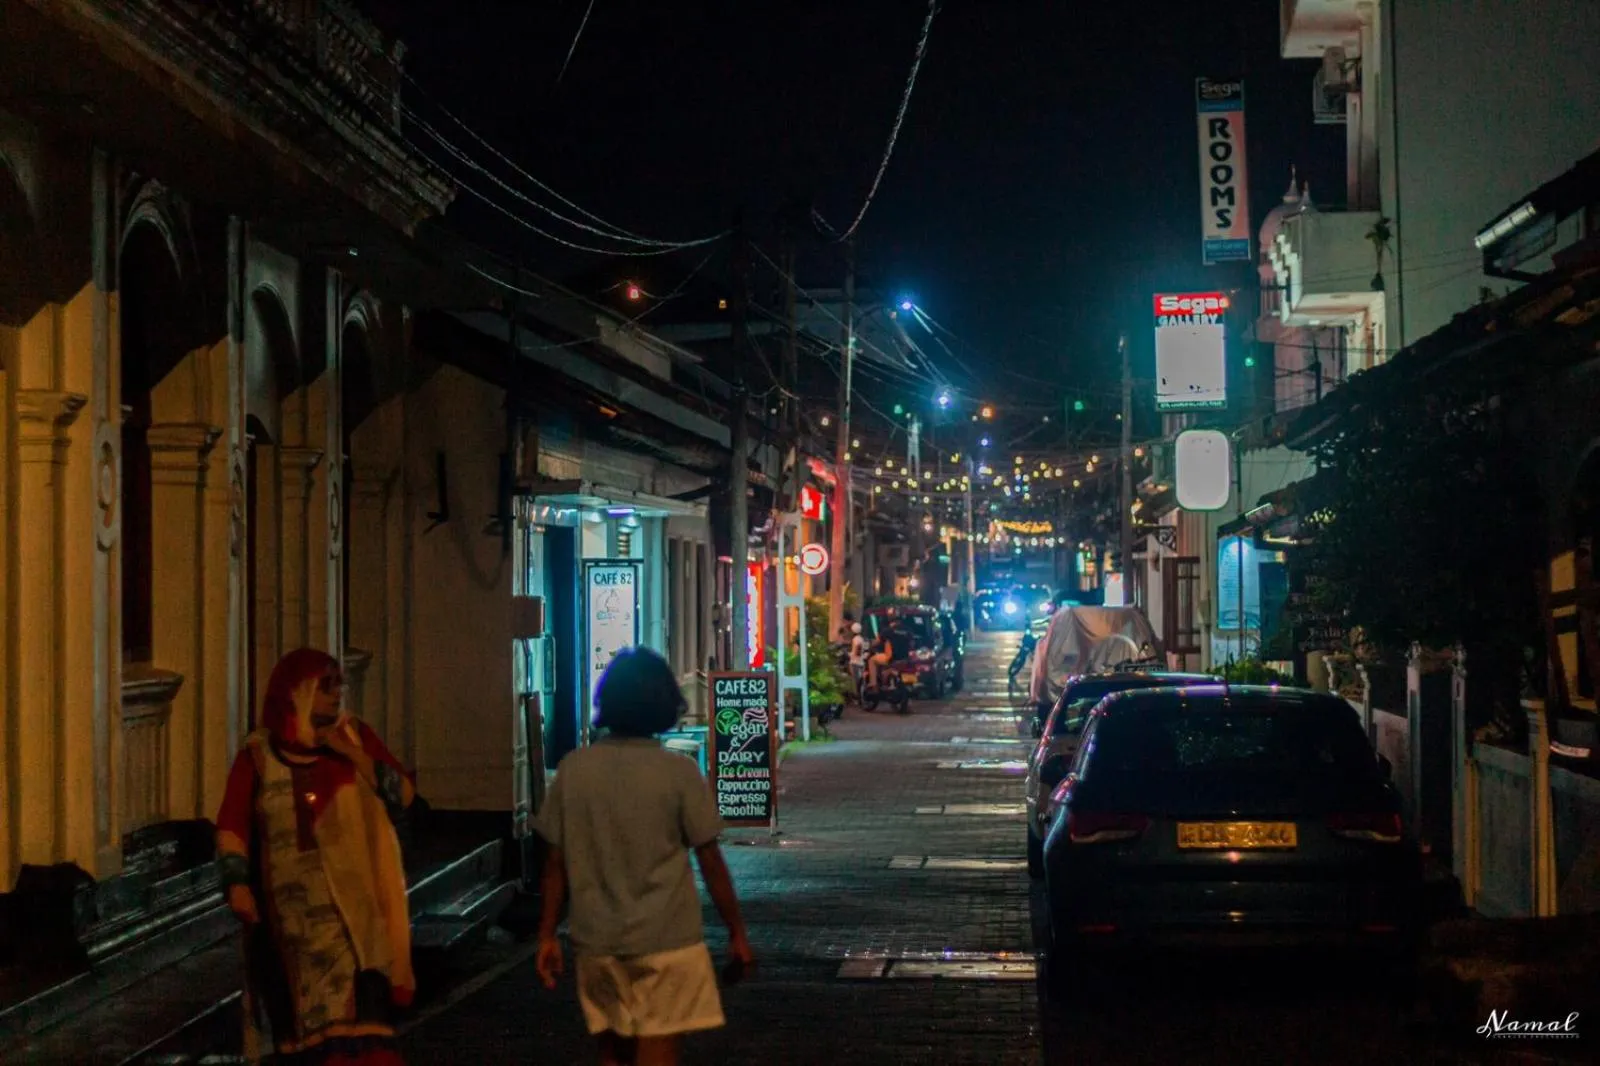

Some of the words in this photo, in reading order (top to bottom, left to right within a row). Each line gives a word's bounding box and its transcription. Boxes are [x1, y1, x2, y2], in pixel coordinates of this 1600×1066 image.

[1208, 118, 1235, 228] ROOMS
[1160, 296, 1219, 314] Sega
[1158, 314, 1218, 327] GALLERY
[620, 572, 632, 585] 82
[716, 698, 742, 708] Home
[743, 697, 768, 708] made
[730, 736, 741, 747] &
[718, 751, 765, 763] DAIRY
[717, 765, 736, 778] Ice
[736, 765, 770, 778] Cream
[717, 779, 770, 792] Cappuccino
[718, 792, 767, 804] Espresso
[719, 803, 767, 816] Smoothie
